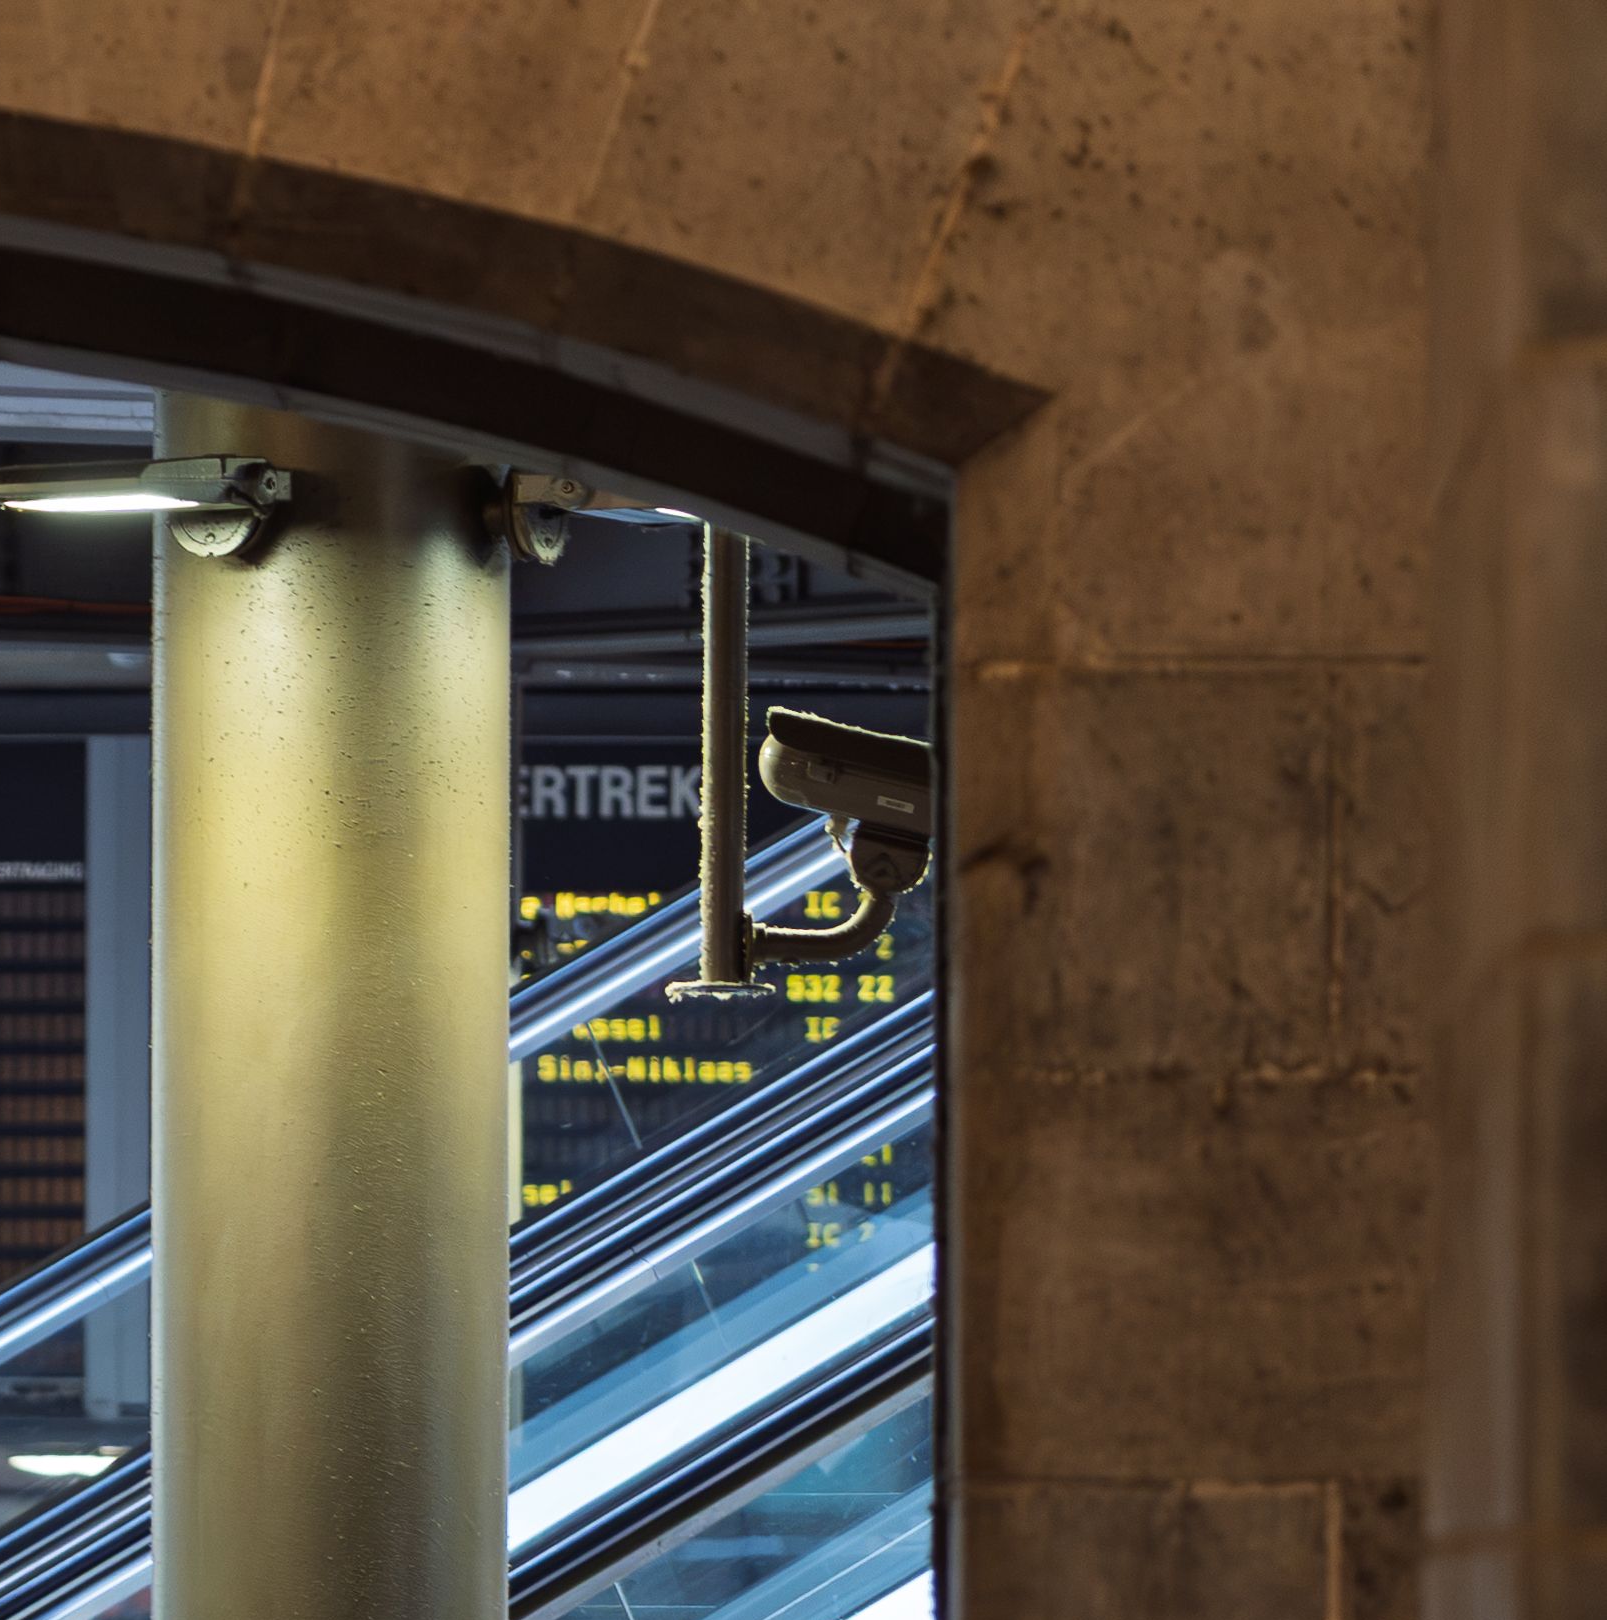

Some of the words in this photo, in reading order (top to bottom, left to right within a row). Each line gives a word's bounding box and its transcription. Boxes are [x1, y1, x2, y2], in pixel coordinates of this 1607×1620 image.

[519, 765, 700, 819] RTREK
[804, 891, 841, 919] IC
[857, 974, 894, 1003] 22
